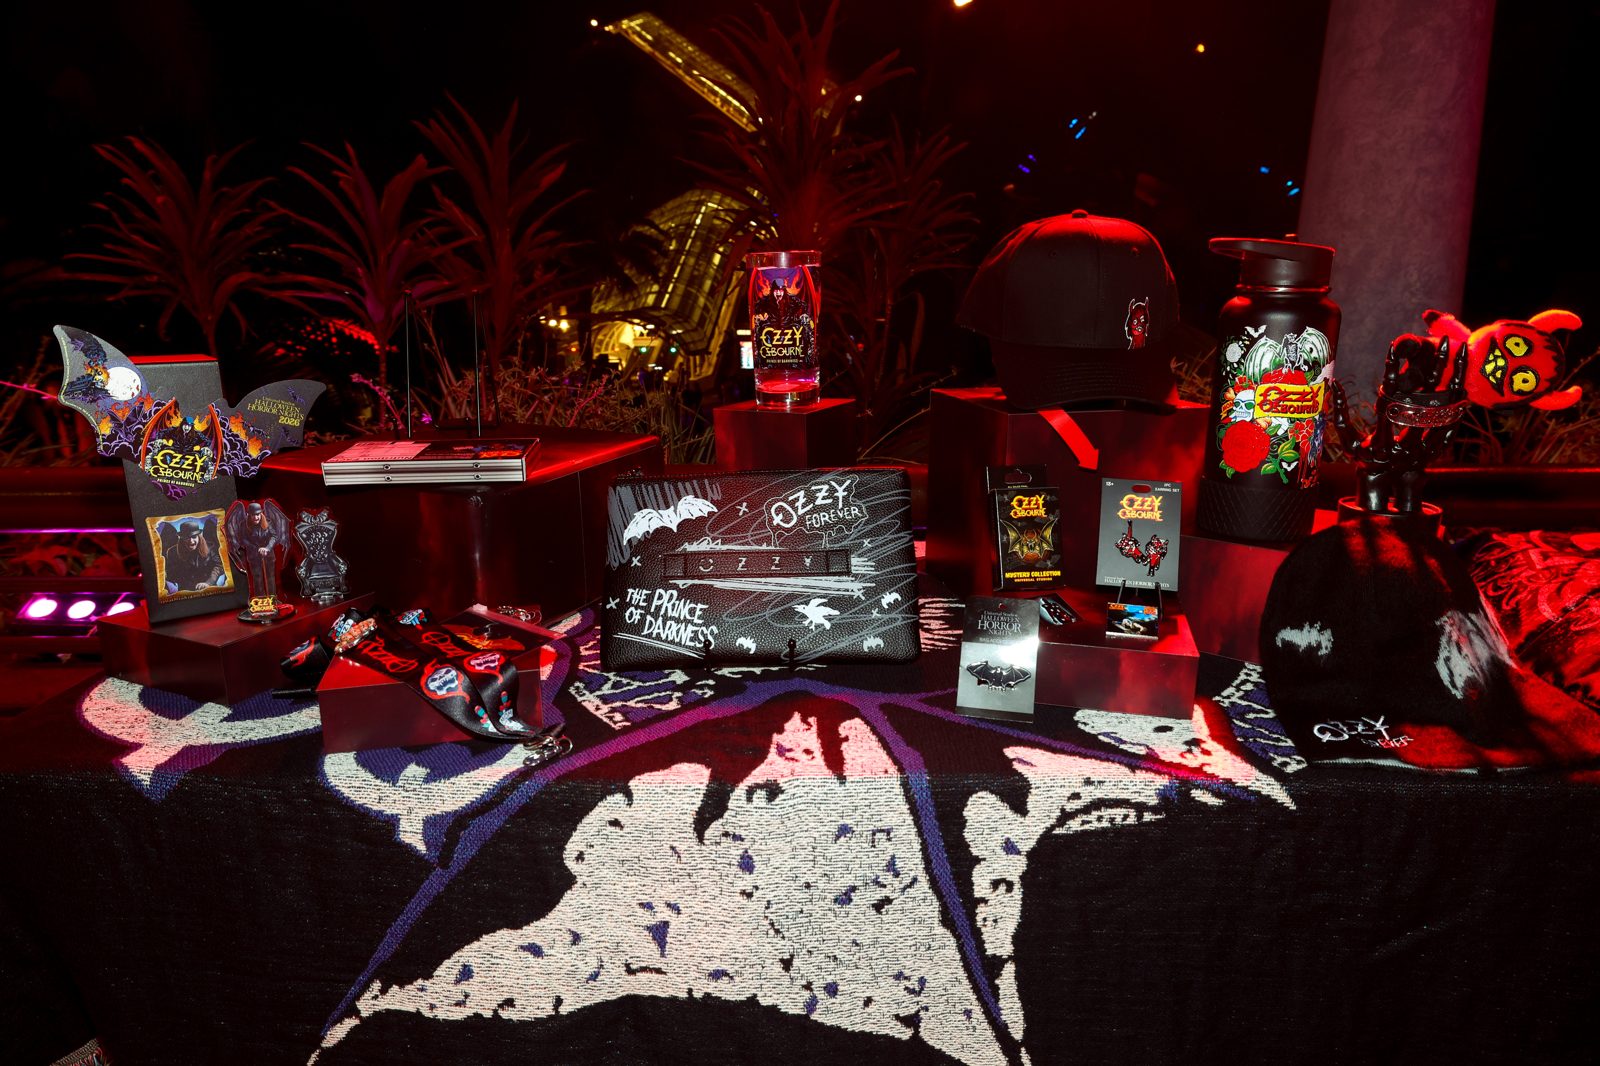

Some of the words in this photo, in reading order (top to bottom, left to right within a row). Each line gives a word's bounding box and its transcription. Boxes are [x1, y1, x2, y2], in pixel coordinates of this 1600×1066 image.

[760, 326, 804, 347] OZZY
[760, 345, 805, 358] OSBOURNE
[1258, 386, 1322, 403] OZZY
[247, 403, 278, 415] HORROR
[279, 409, 304, 421] NIGHTS
[254, 399, 301, 413] HALLOWEEN
[278, 415, 301, 427] 2026
[154, 449, 207, 473] OZZY
[149, 465, 205, 484] OSBOURNE
[769, 479, 852, 528] OZZY
[1011, 494, 1045, 510] OZZY
[1120, 494, 1163, 512] OZZY
[805, 506, 863, 530] FOREVER
[1010, 507, 1048, 519] OSBOURNE
[1117, 508, 1164, 521] OSBOURNE
[1031, 570, 1061, 578] COLLECTION
[626, 588, 652, 606] THE
[650, 589, 710, 624] PRINCE
[977, 619, 1022, 634] HORROR
[980, 614, 1021, 624] HALLOWEEN
[625, 606, 645, 624] OF
[641, 614, 719, 650] DARKNESS
[988, 628, 1013, 636] NIGHTS
[1313, 715, 1390, 743] OZZY
